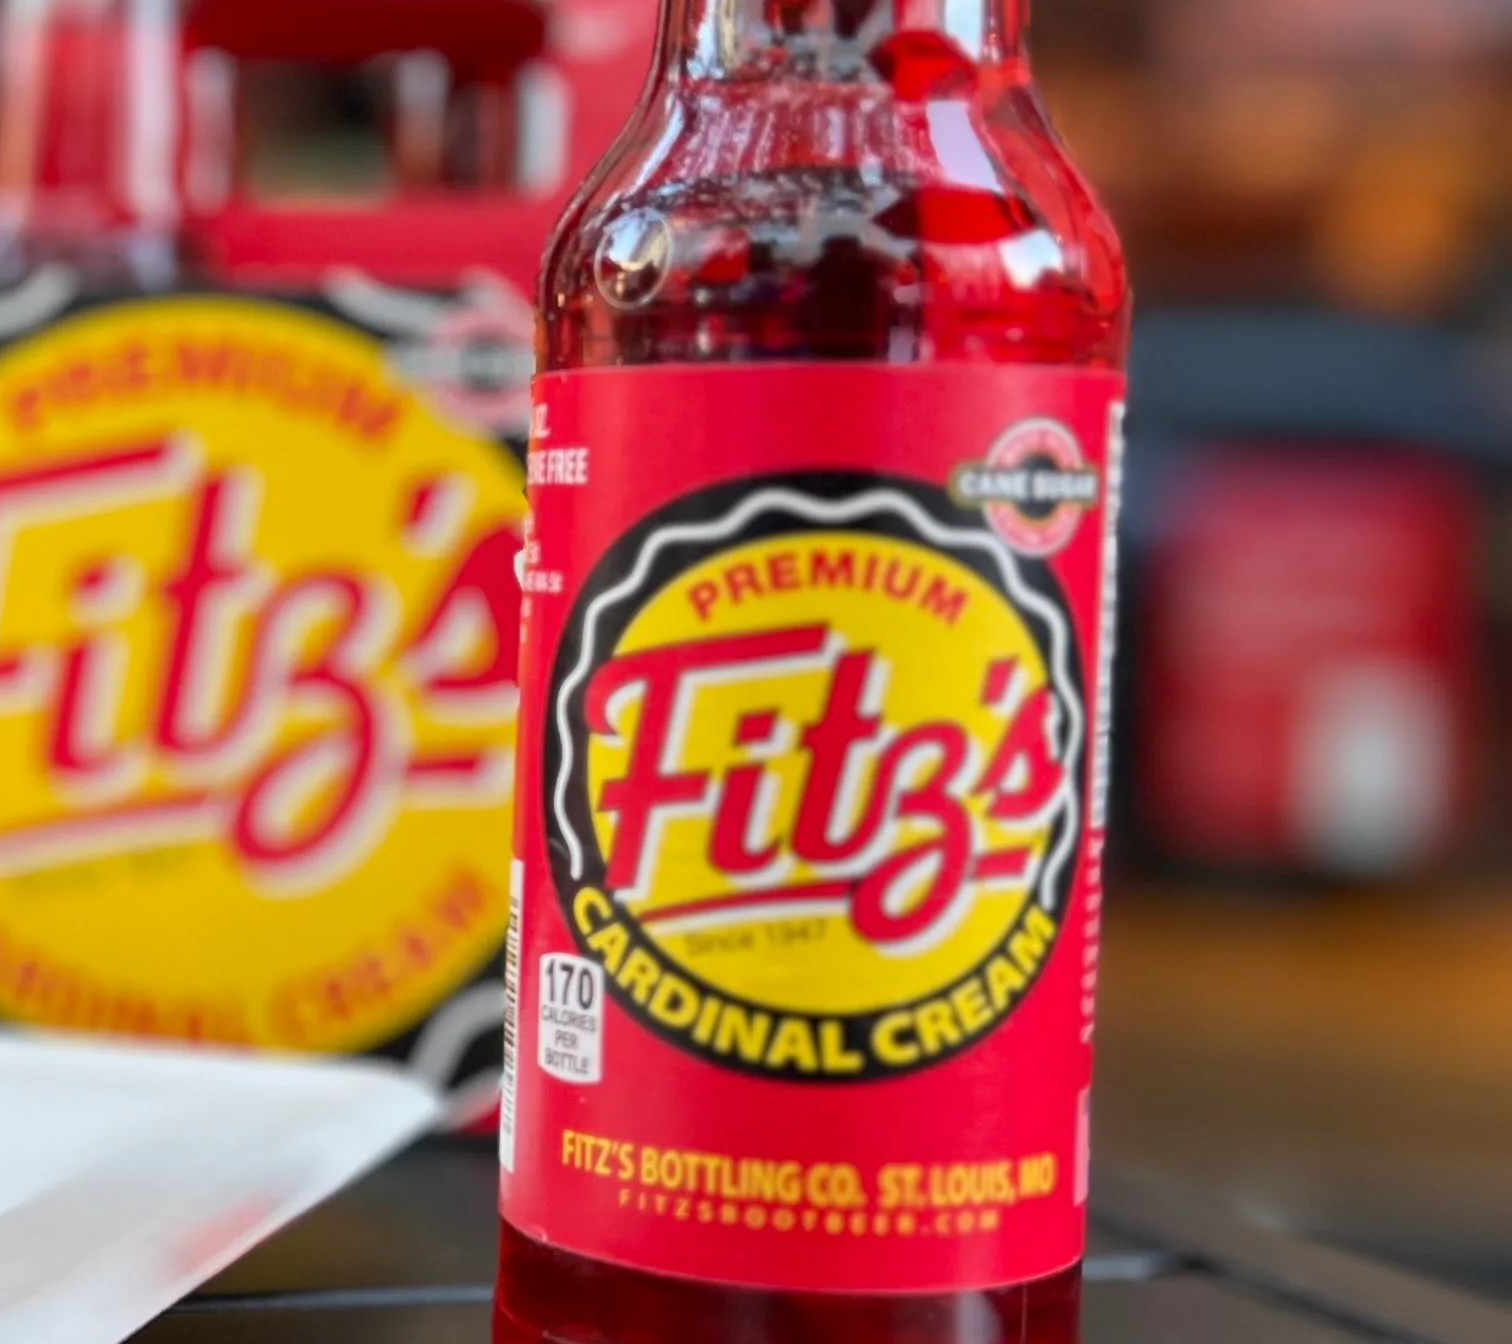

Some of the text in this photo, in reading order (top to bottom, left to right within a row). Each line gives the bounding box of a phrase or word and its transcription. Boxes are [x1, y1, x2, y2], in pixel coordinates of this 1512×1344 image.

[688, 547, 970, 628] PREMIUM
[585, 622, 1072, 958] Fitz's
[546, 958, 594, 1010] 170
[573, 887, 865, 1072] CARDINAL
[872, 905, 1057, 1066] CREAM
[541, 1004, 597, 1033] CALORIES
[554, 1029, 579, 1051] PER
[544, 1049, 590, 1075] BOTTLE
[562, 1129, 635, 1181] FITZ'S
[640, 1145, 803, 1205] BOTTLING
[805, 1161, 867, 1207] CO.
[878, 1161, 926, 1208] ST.
[1018, 1152, 1057, 1196] MO
